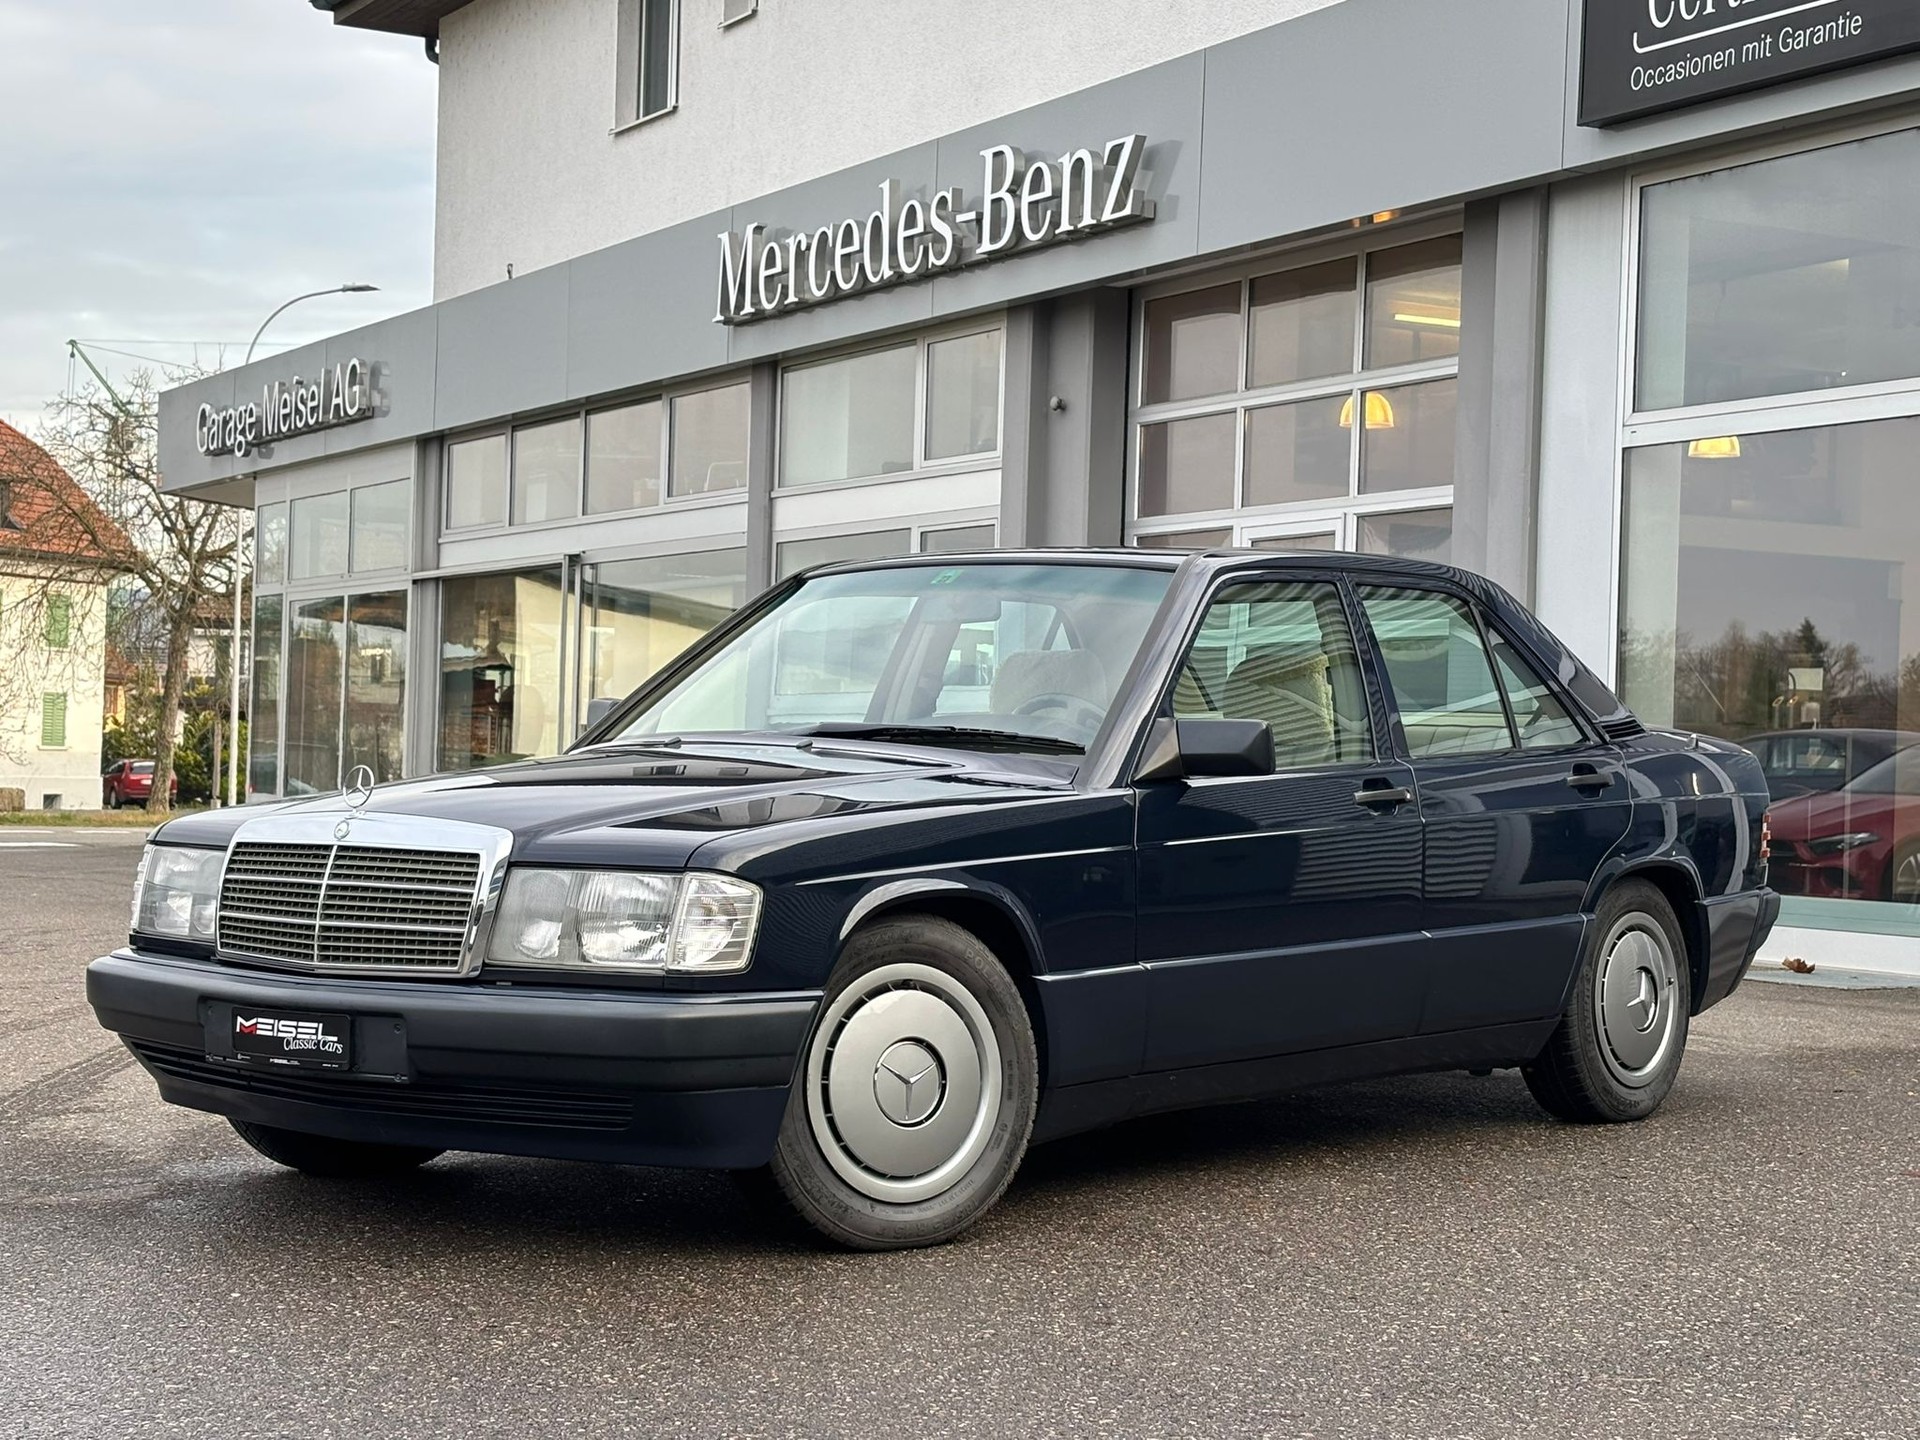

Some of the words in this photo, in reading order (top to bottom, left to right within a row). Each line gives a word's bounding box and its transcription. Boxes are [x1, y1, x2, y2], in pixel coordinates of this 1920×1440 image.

[1630, 47, 1735, 91] Occasionen
[1742, 33, 1773, 63] mit
[1779, 11, 1863, 53] Garantie
[712, 133, 1148, 324] Mercedes-Benz
[196, 402, 256, 458] Garage
[262, 367, 325, 436] Meisel
[330, 356, 361, 420] AG
[235, 1015, 338, 1042] MEISEL
[283, 1035, 318, 1051] Classic
[319, 1036, 344, 1054] Cars
